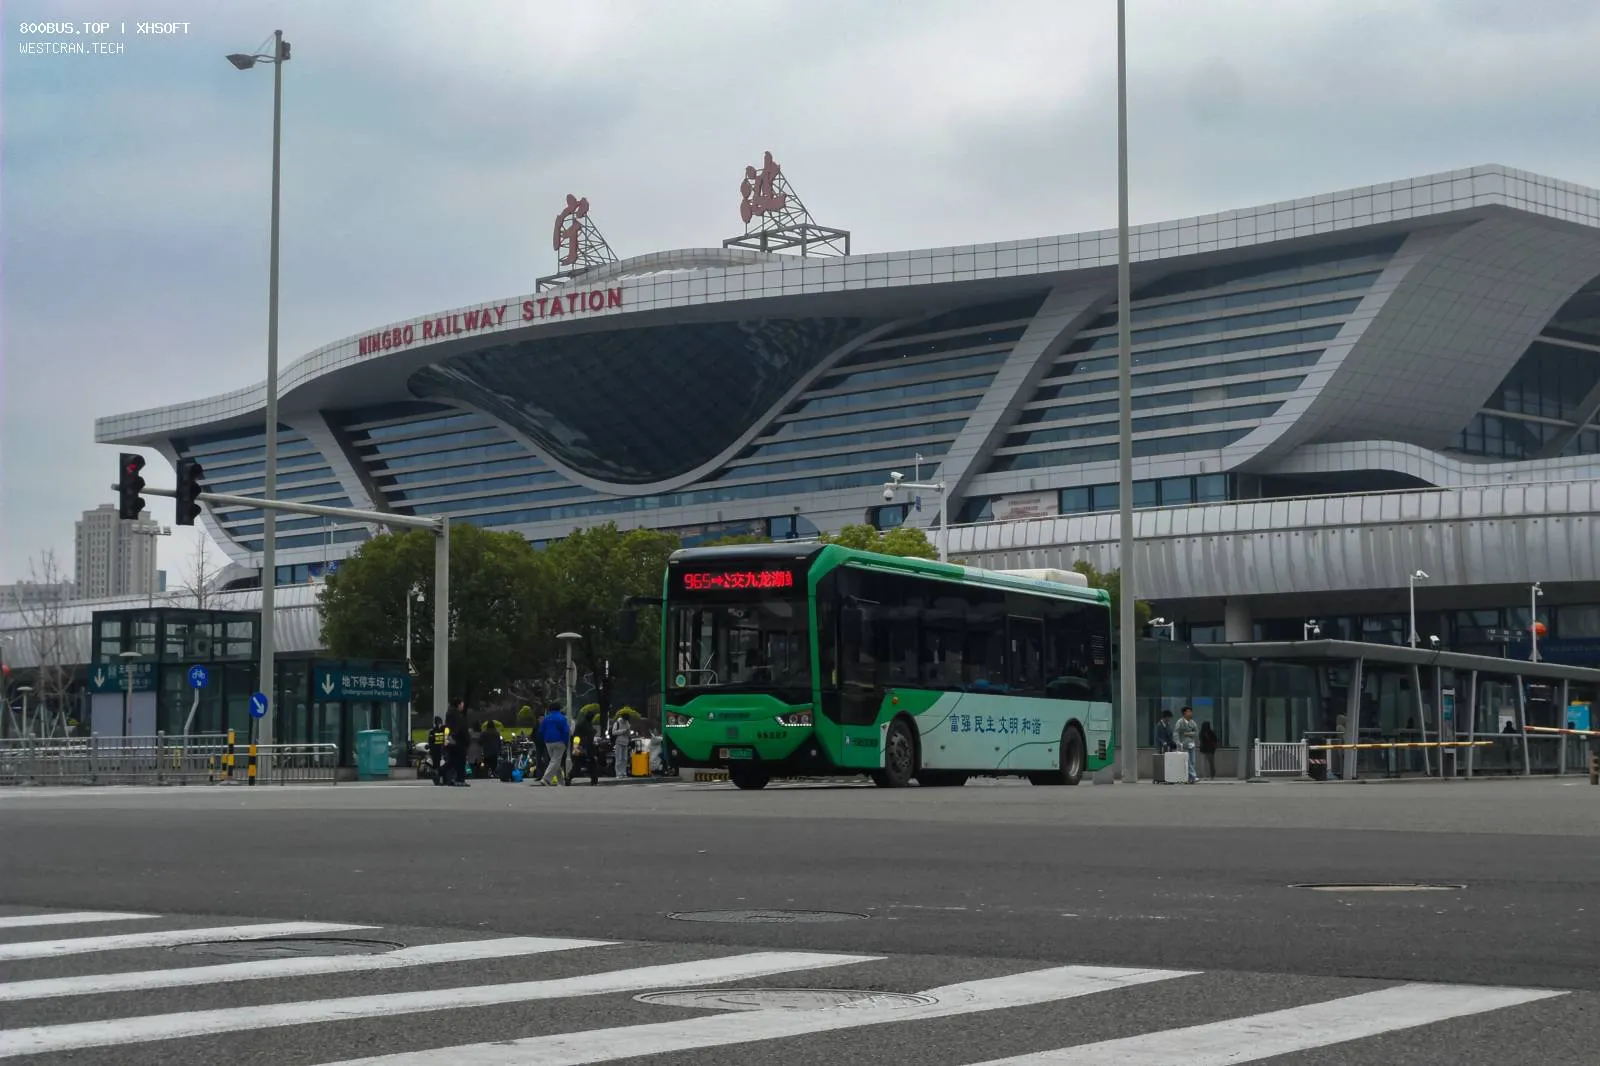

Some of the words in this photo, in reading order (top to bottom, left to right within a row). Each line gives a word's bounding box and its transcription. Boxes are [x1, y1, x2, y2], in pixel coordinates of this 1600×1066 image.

[358, 325, 414, 355] NINGBO
[422, 305, 507, 340] RAILWAY
[522, 287, 622, 321] STATION
[684, 573, 711, 589] 965
[949, 714, 1041, 735] 富强民主文明和谐
